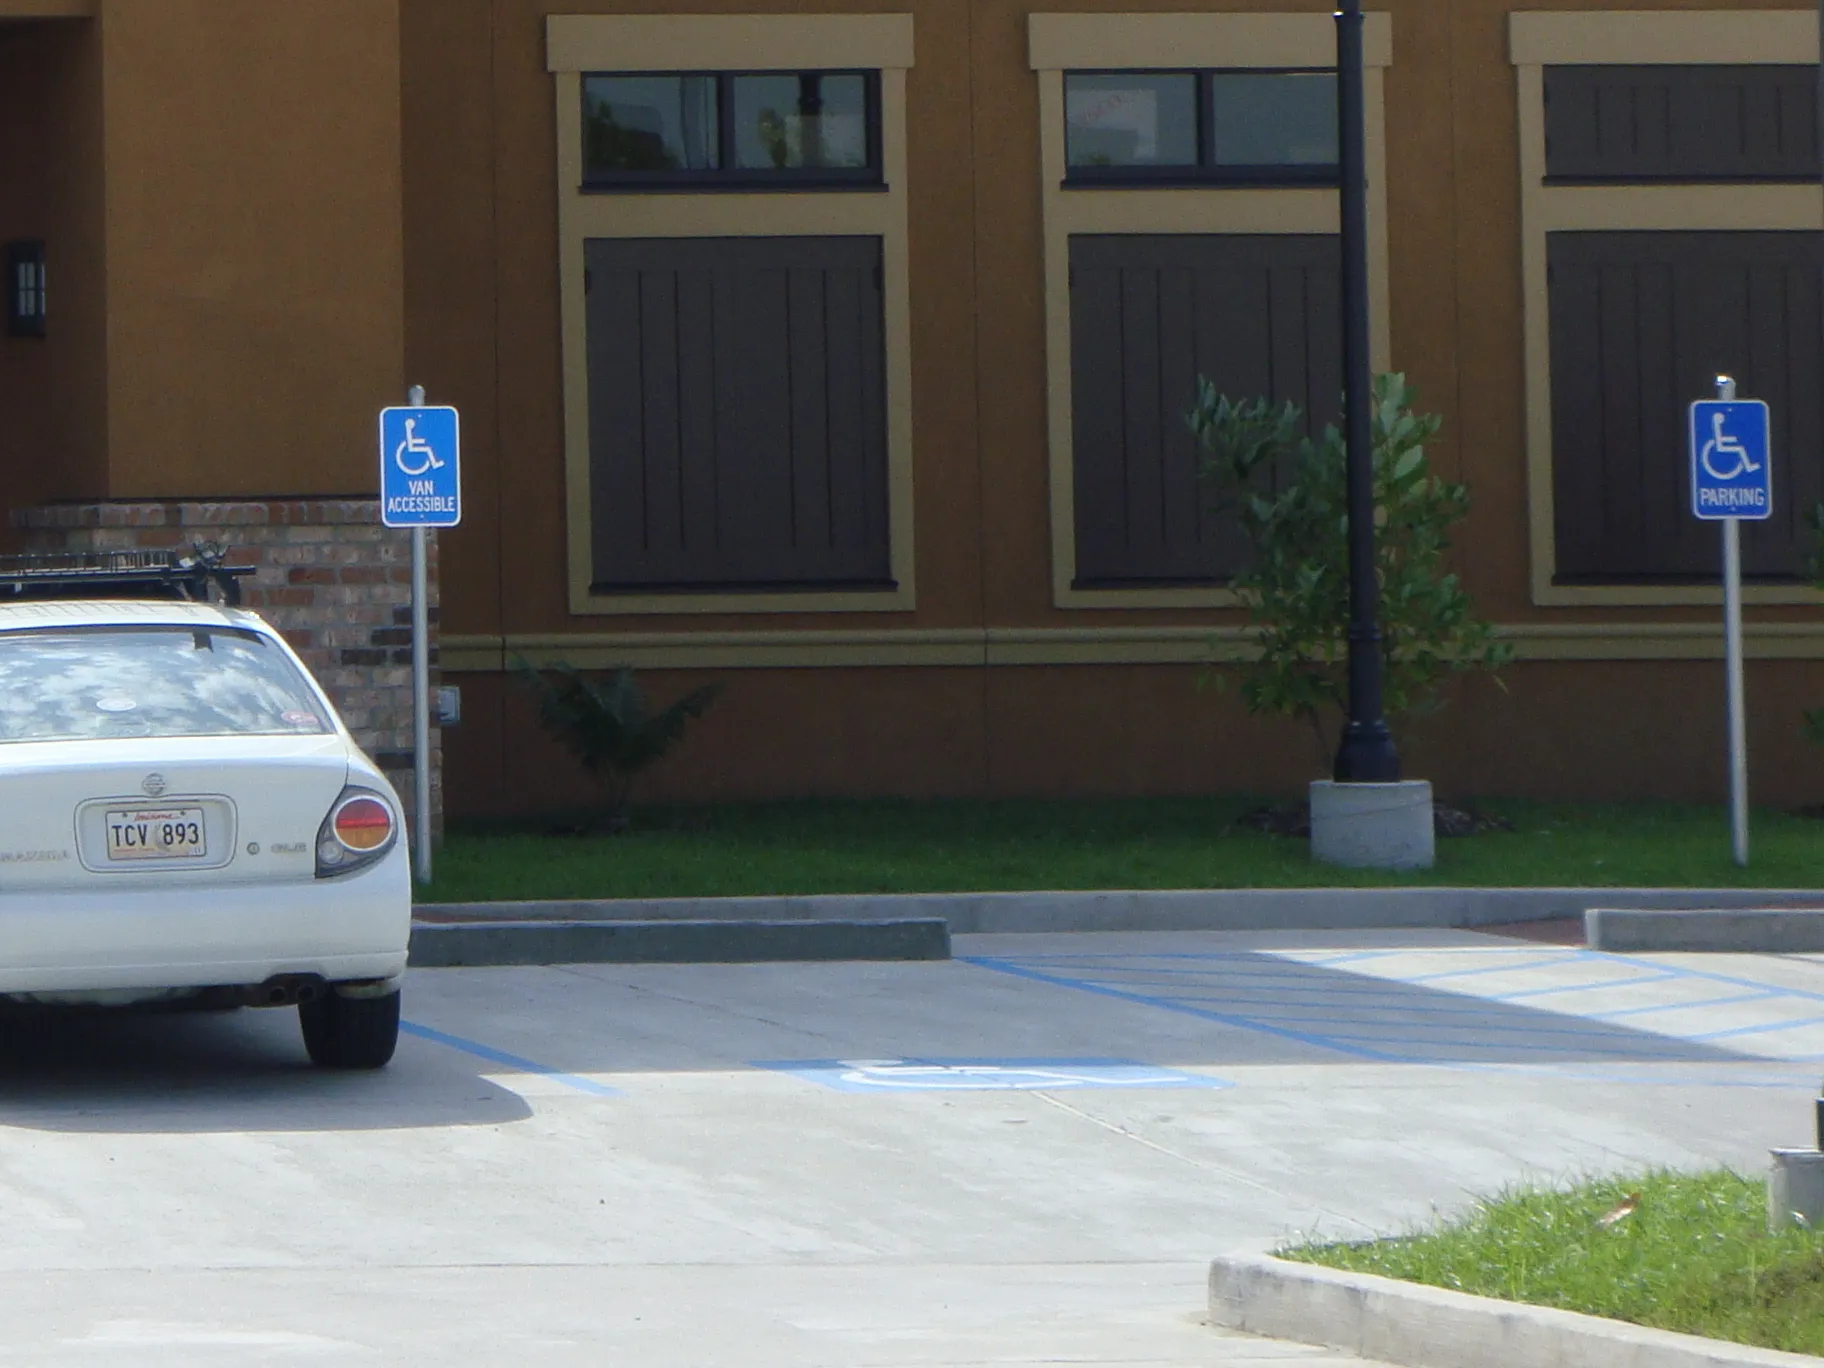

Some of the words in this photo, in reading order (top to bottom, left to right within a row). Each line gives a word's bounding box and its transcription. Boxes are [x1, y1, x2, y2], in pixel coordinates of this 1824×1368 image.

[408, 480, 433, 495] VAN
[387, 497, 456, 513] ACCESSIBLE
[1700, 488, 1765, 506] PARKING
[111, 823, 149, 847] TCV
[162, 822, 200, 846] 893
